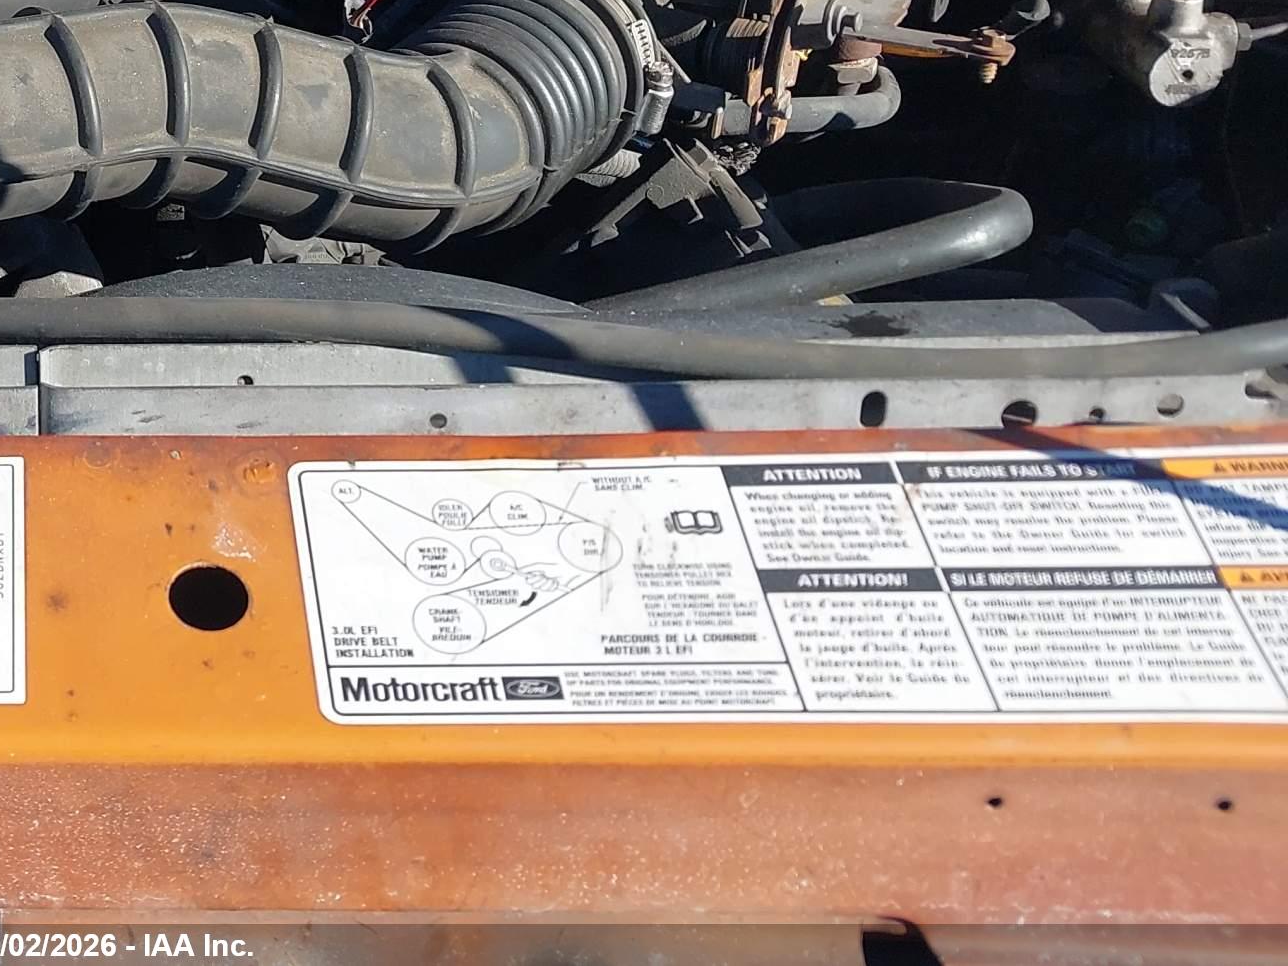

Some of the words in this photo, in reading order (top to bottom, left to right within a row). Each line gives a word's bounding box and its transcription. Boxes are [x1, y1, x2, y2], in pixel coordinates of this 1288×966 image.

[763, 468, 862, 482] ATTENTION
[927, 466, 942, 478] IF
[945, 465, 1008, 478] ENGINE
[1010, 465, 1056, 477] FAILS
[1057, 464, 1082, 477] TO
[1085, 464, 1136, 477] START
[797, 573, 909, 587] ATTENTION!
[950, 573, 966, 586] SI
[969, 572, 988, 586] LE
[988, 572, 1053, 586] MOTEUR
[1054, 572, 1111, 586] REFUSE
[1113, 571, 1134, 585] DE
[1136, 569, 1217, 585] DÉMARRER
[332, 626, 357, 634] 3.0L
[361, 626, 378, 634] EFI
[334, 637, 367, 646] DRIVE
[372, 637, 398, 646] BELT
[601, 634, 659, 644] PARCOURS
[665, 634, 678, 643] DE
[684, 634, 697, 643] LA
[703, 634, 757, 643] COURROIE
[336, 649, 414, 658] INSTALLATION
[604, 646, 650, 655] MOTEUR
[666, 646, 672, 655] L
[676, 645, 693, 654] EFI
[340, 677, 502, 702] Motorcraft
[517, 681, 549, 695] Ford
